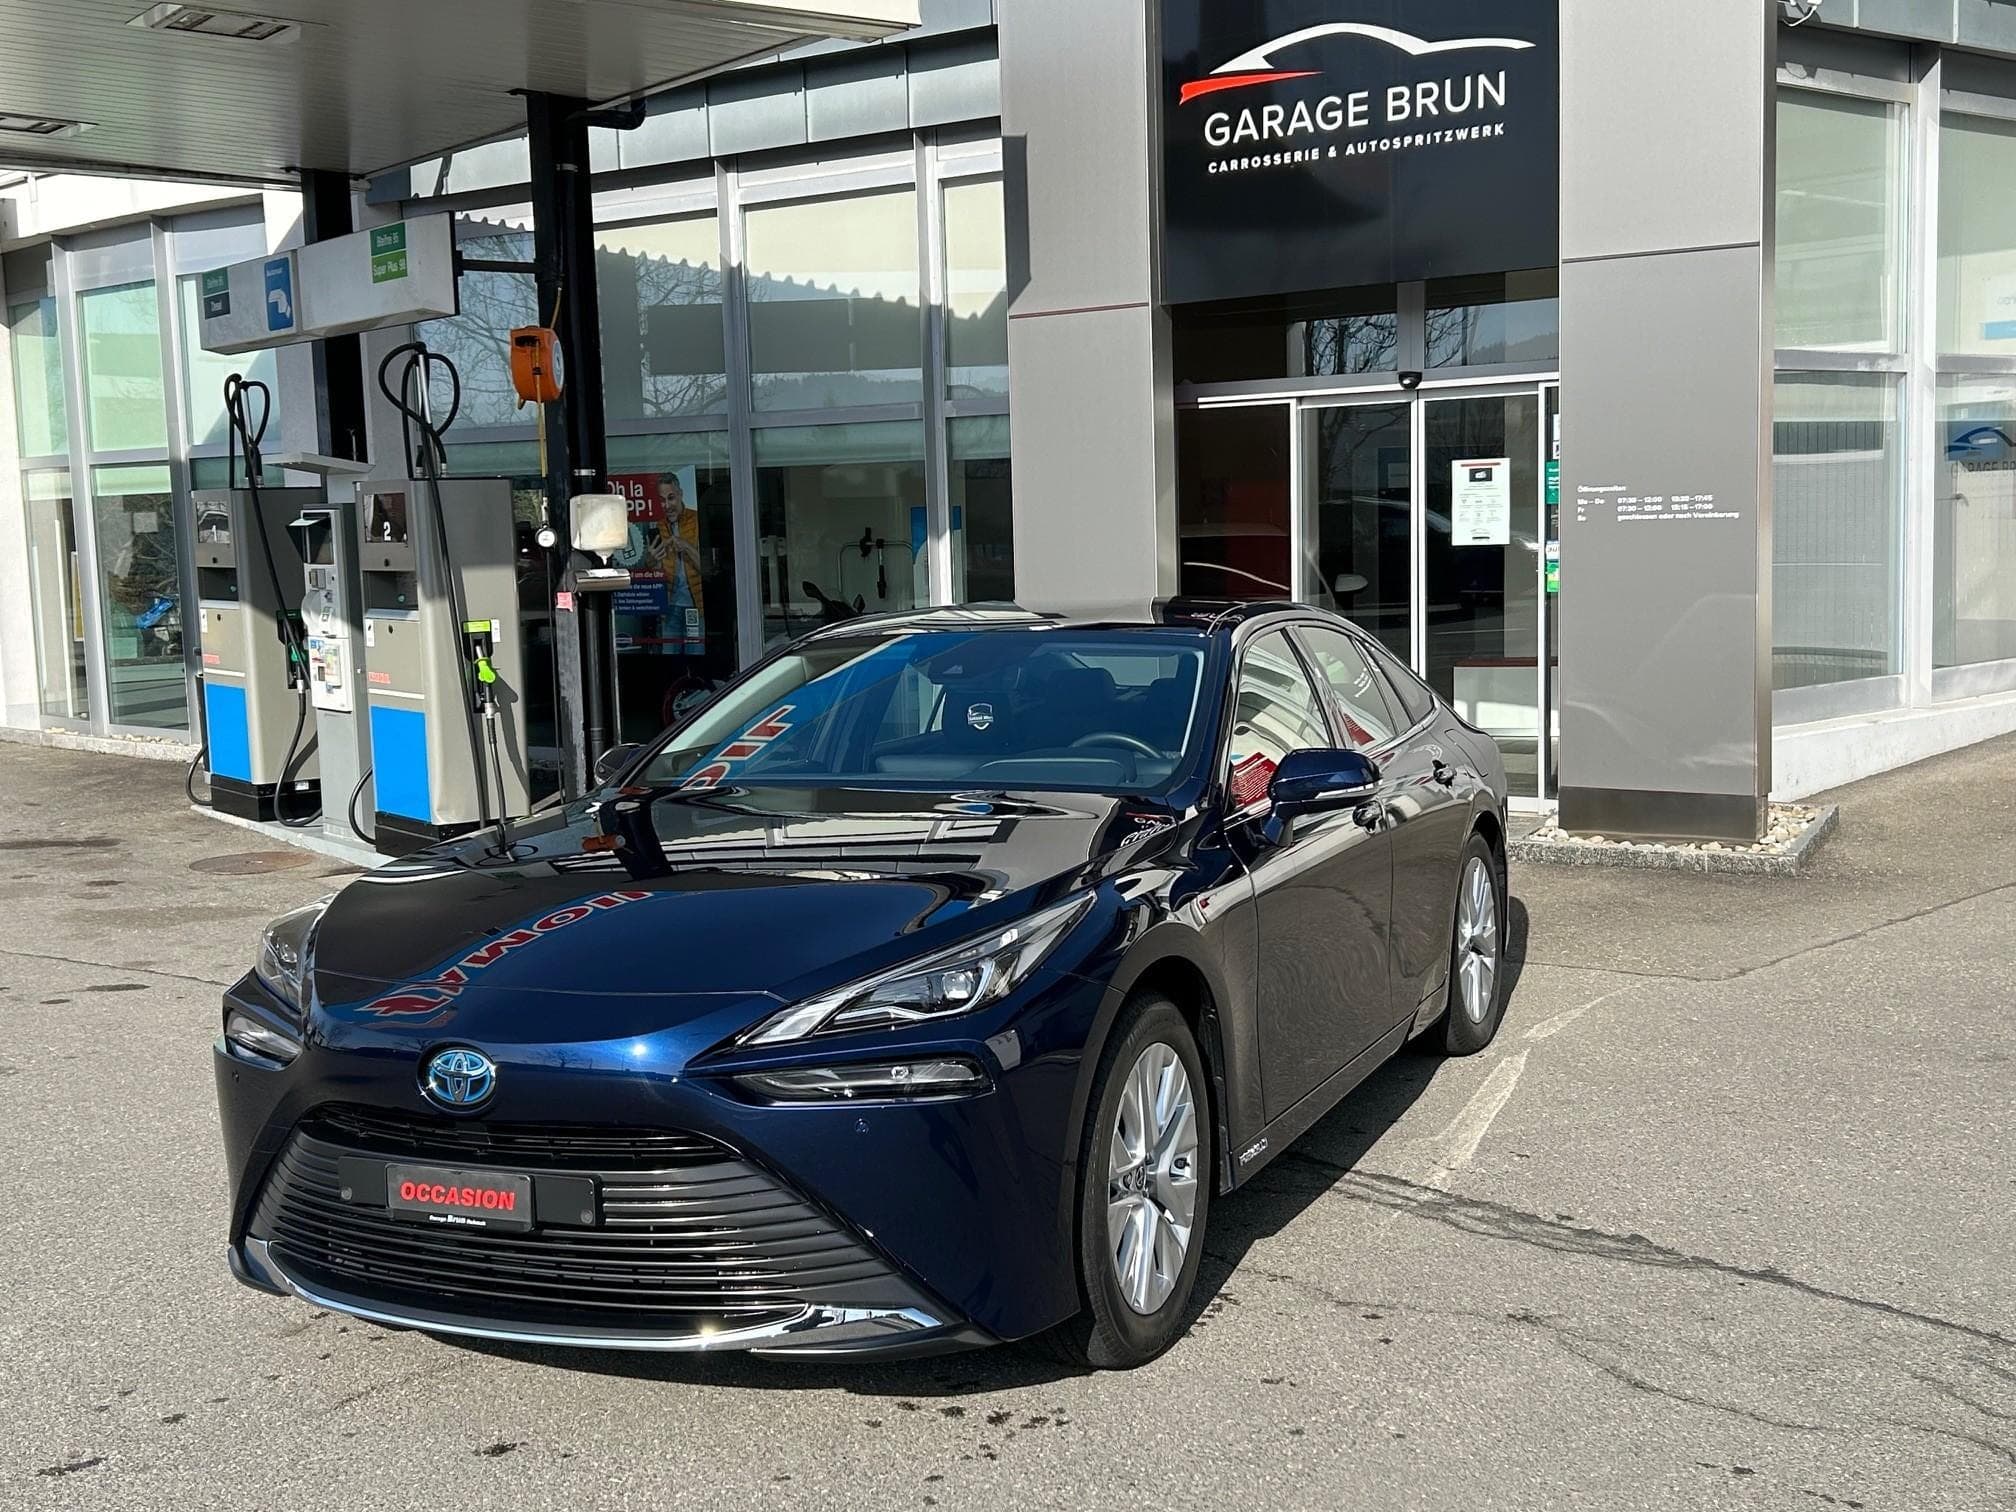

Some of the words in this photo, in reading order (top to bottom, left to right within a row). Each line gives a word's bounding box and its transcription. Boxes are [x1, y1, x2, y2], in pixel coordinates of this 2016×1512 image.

[1204, 91, 1369, 147] GARAGE
[1386, 70, 1507, 122] BRUN
[1207, 148, 1321, 174] CARROSSERIE
[1327, 145, 1338, 158] &
[1345, 123, 1506, 156] AUTOSPRITZWERK
[629, 480, 644, 497] la
[626, 499, 653, 517] PP!
[383, 521, 392, 541] 2
[400, 1181, 516, 1211] OCCASION
[447, 1214, 466, 1224] Brun
